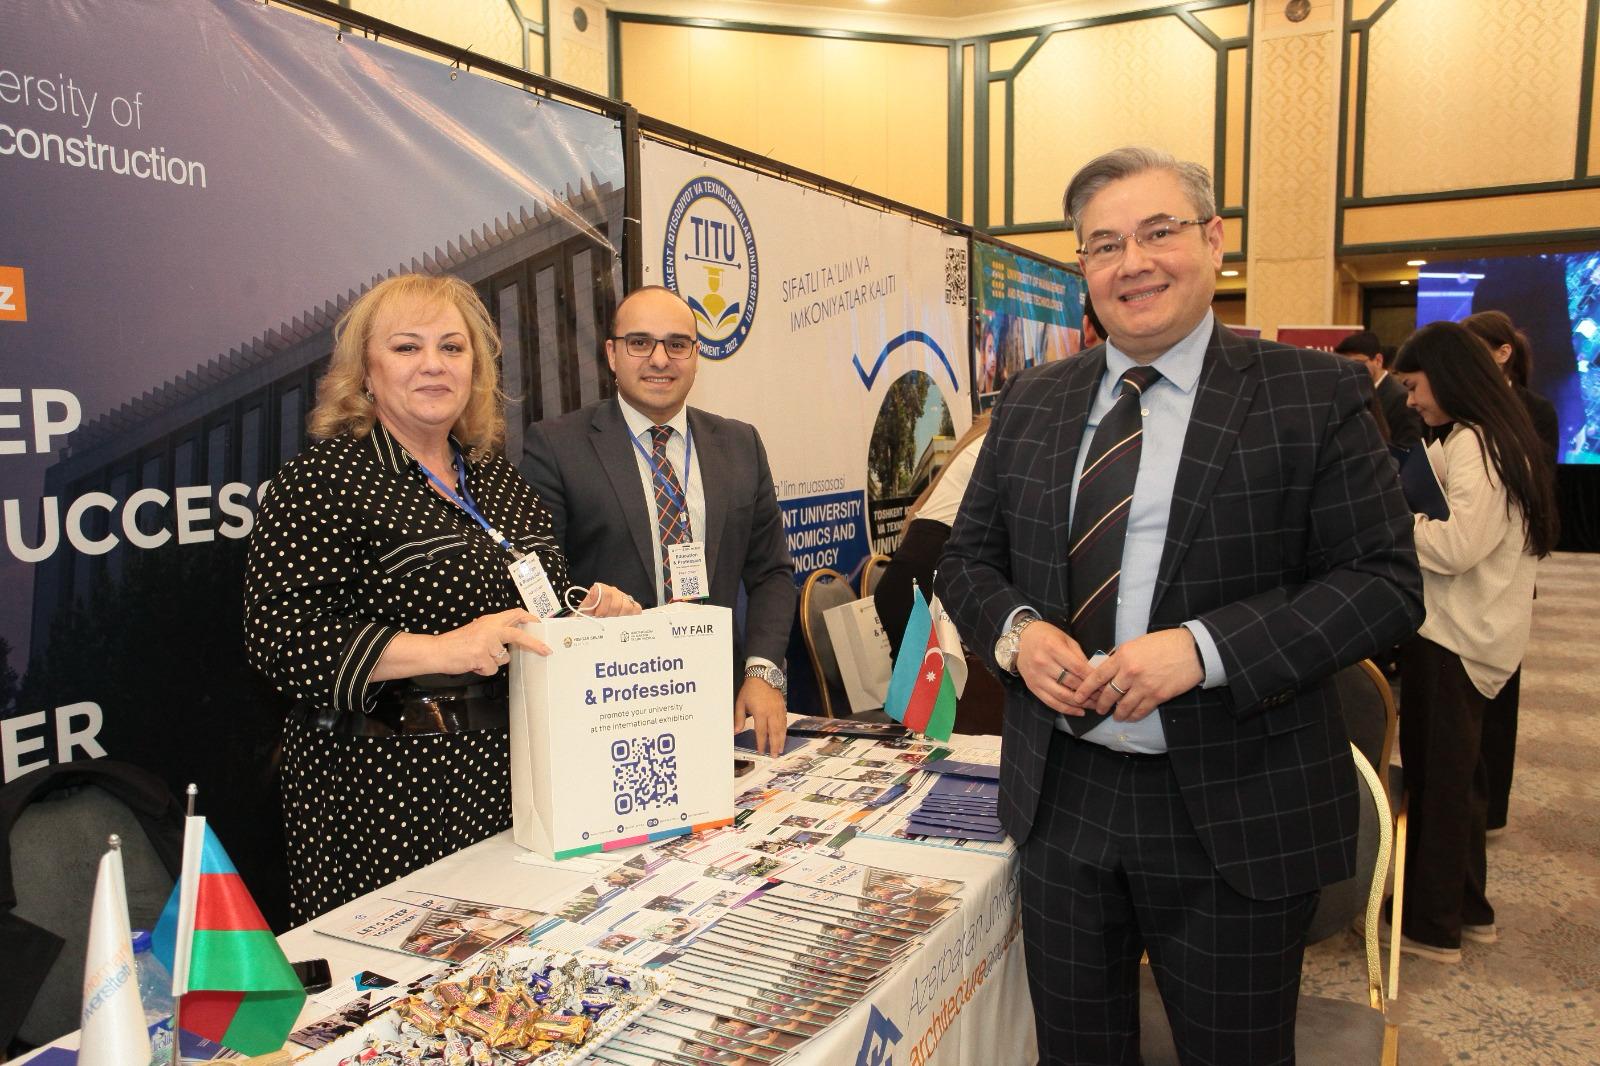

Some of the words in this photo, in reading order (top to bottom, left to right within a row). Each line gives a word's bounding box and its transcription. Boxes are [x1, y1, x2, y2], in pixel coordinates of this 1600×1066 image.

[111, 92, 143, 130] of
[0, 124, 207, 188] construction
[691, 216, 735, 262] TITU
[693, 182, 703, 195] VA
[704, 181, 753, 244] TEXNOLOGIYALARI
[744, 246, 758, 324] UNIVERSITETI
[782, 270, 819, 303] SIFATLI
[856, 255, 871, 275] VA
[790, 285, 867, 333] IMKONIYATLAR
[869, 274, 896, 300] KALITI
[798, 474, 846, 494] muassasasi
[4, 479, 272, 563] UCCES
[800, 500, 861, 525] UNIVERSITY
[785, 528, 831, 551] NOMICS
[832, 523, 856, 542] AND
[792, 548, 839, 574] NOLOGY
[672, 626, 687, 636] MY
[690, 624, 714, 634] FAIR
[595, 656, 684, 679] Education
[585, 689, 597, 705] &
[602, 679, 697, 704] Profession
[590, 725, 598, 734] at
[599, 722, 611, 732] the
[612, 718, 657, 731] international
[659, 713, 694, 725] exhibition
[599, 710, 630, 722] promote
[631, 708, 647, 719] your
[648, 703, 683, 715] university
[0, 701, 108, 784] ER
